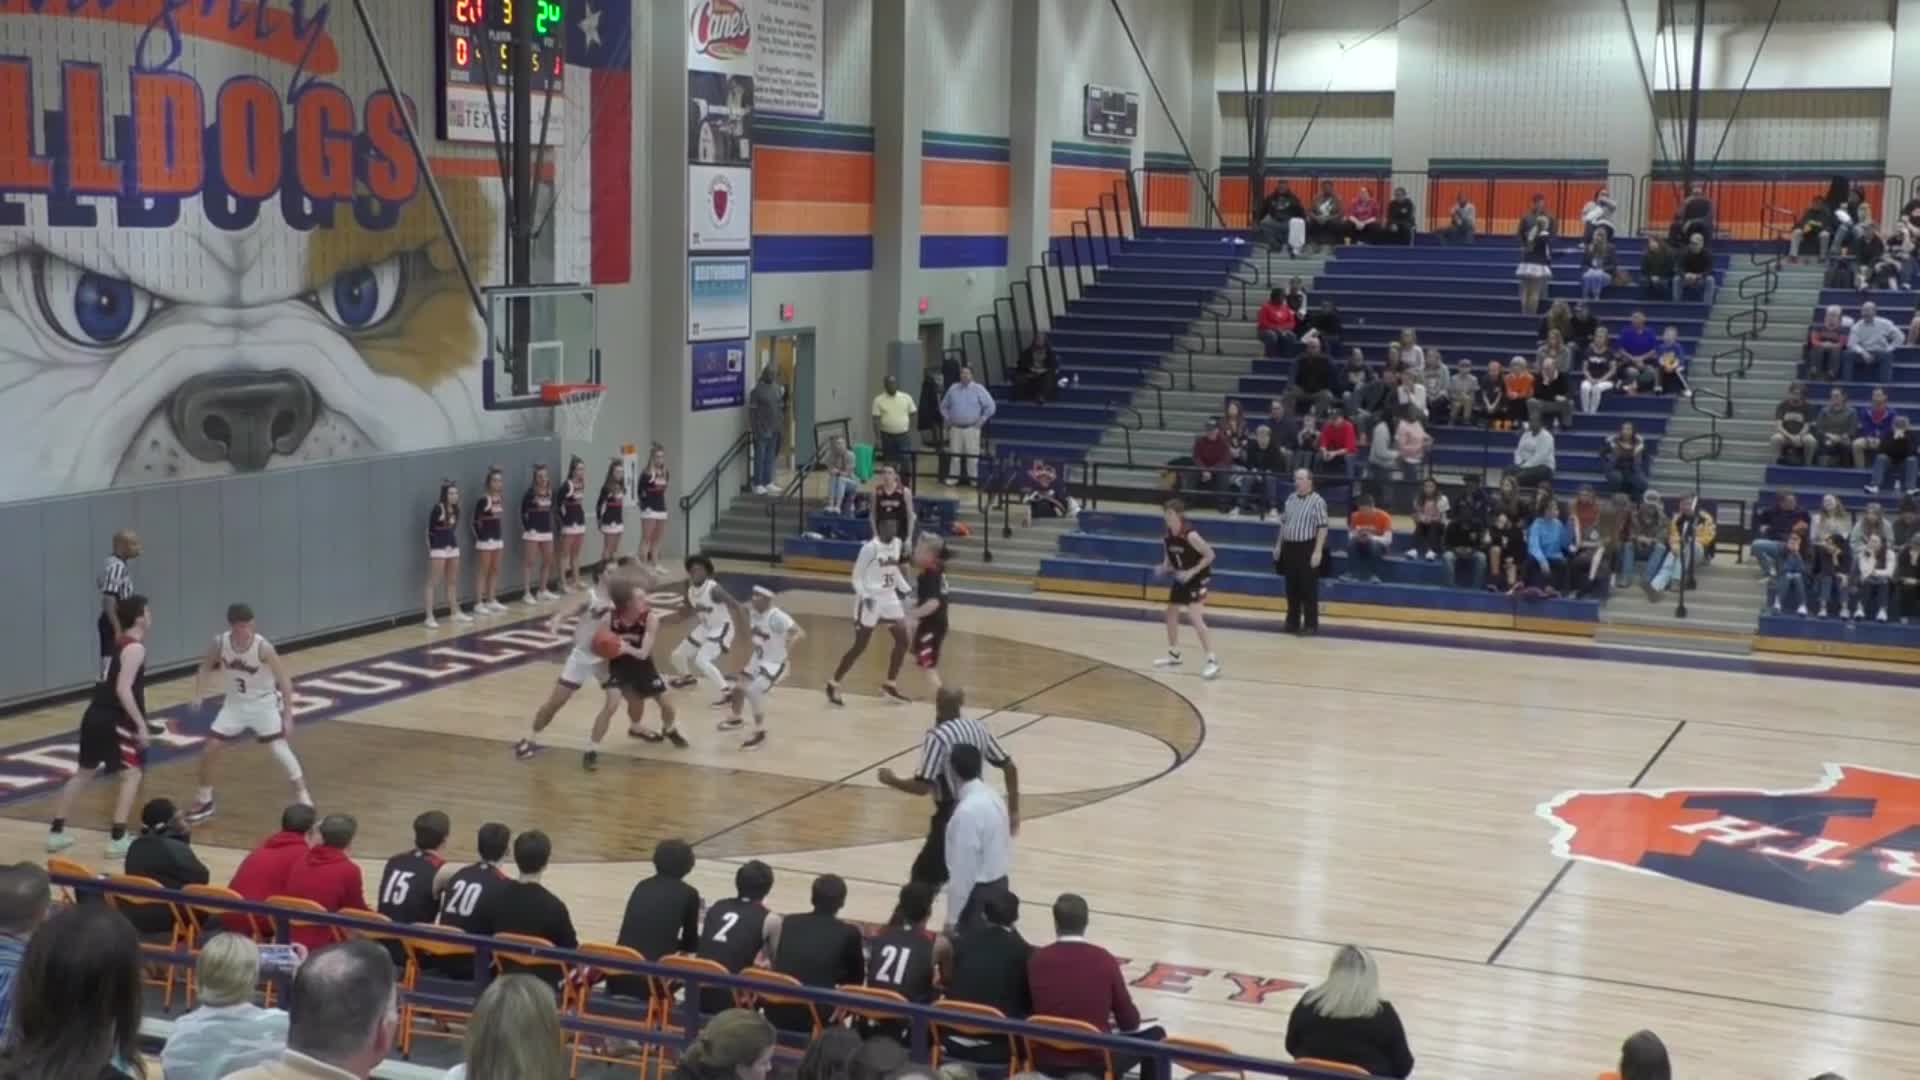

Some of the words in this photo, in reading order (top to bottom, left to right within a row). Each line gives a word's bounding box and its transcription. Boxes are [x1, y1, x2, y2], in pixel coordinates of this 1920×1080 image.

[465, 109, 510, 130] TEXS
[233, 677, 247, 694] 3
[382, 869, 416, 905] 15
[446, 879, 483, 917] 20
[711, 911, 740, 943] 2
[875, 945, 911, 985] 21
